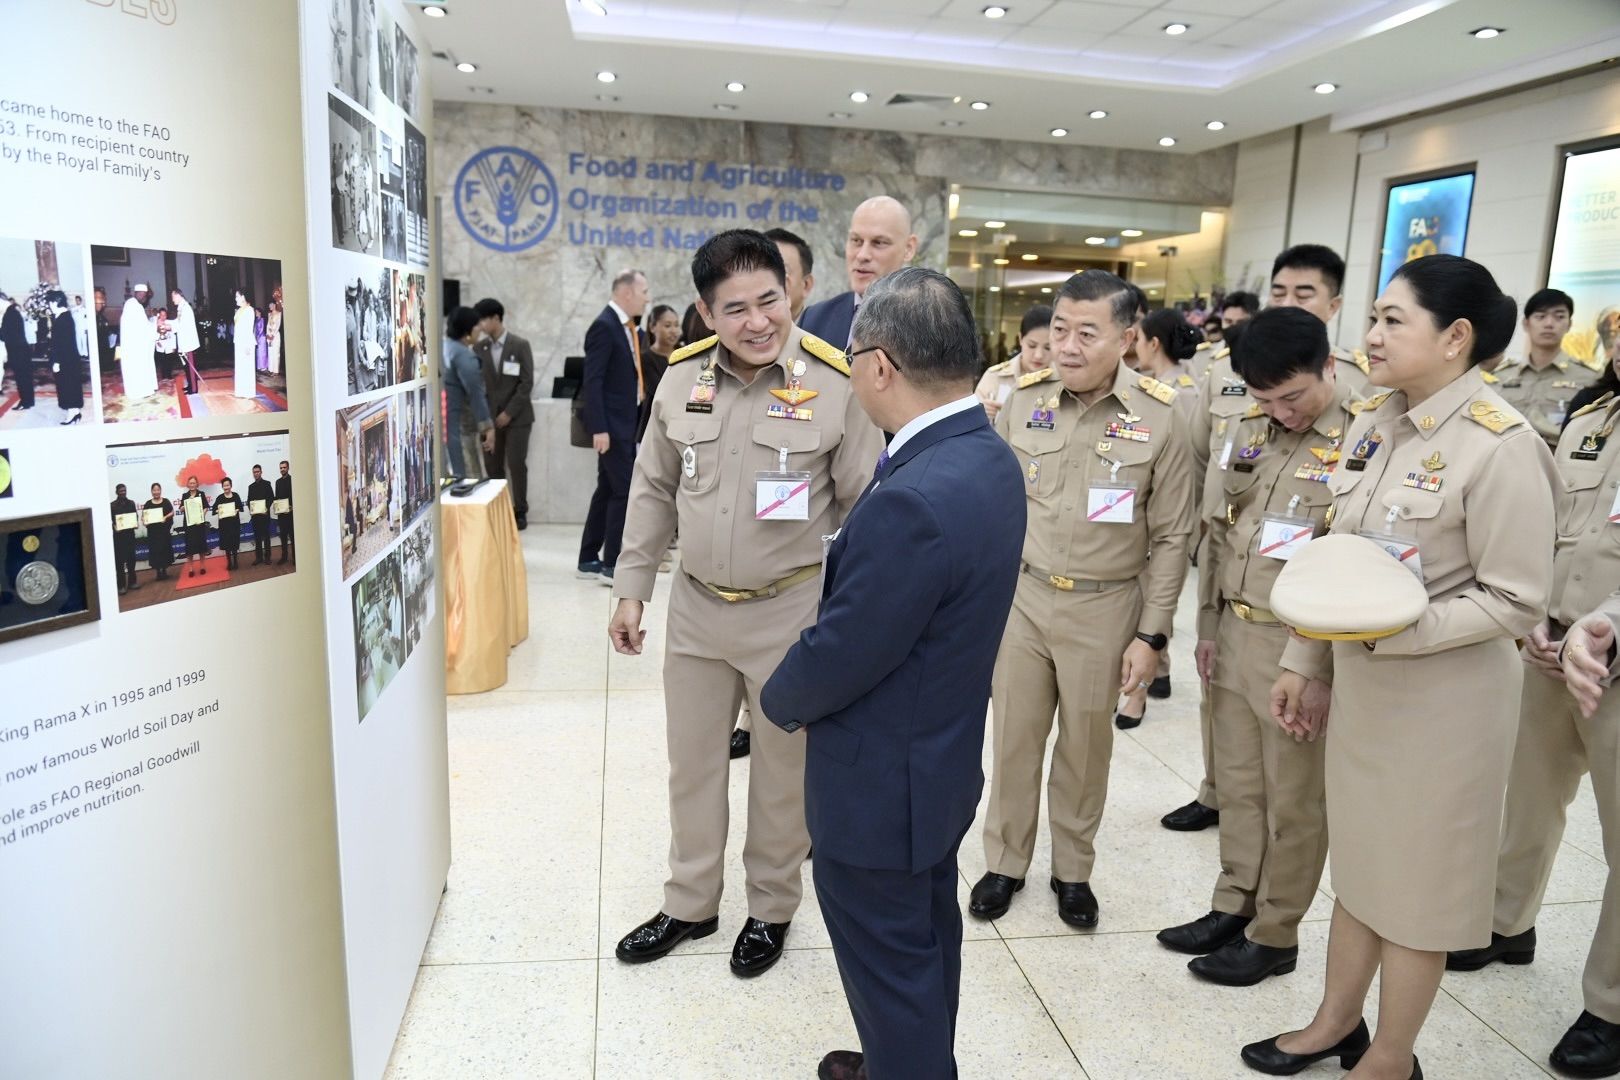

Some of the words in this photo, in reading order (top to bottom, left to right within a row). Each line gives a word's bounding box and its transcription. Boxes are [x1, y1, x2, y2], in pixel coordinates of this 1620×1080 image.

[0, 99, 46, 118] came
[50, 104, 94, 127] home
[98, 116, 113, 131] to
[117, 118, 139, 136] the
[143, 123, 170, 141] FAO
[2, 141, 21, 163] by
[27, 147, 52, 164] the
[57, 151, 99, 173] Royal
[103, 158, 161, 182] Family's
[26, 123, 67, 144] From
[72, 135, 135, 156] recipient
[138, 146, 189, 168] country
[568, 152, 638, 179] Food
[645, 159, 696, 183] and
[701, 159, 847, 192] Agriculture
[567, 187, 738, 219] Organization
[746, 197, 773, 220] of
[779, 200, 820, 224] the
[567, 221, 655, 248] United
[34, 710, 77, 732] Rama
[81, 703, 91, 718] X
[95, 700, 107, 714] in
[112, 687, 145, 708] 1995
[148, 678, 172, 697] and
[176, 669, 206, 688] 1999
[6, 762, 39, 784] now
[43, 742, 98, 771] famous
[101, 725, 140, 749] World
[144, 716, 167, 735] Soil
[171, 711, 194, 726] Day
[197, 699, 219, 717] and
[0, 808, 25, 825] ole
[29, 801, 48, 815] as
[51, 785, 81, 807] FAO
[84, 761, 143, 794] Regional
[147, 740, 201, 770] Goodwill
[21, 806, 80, 838] improve
[84, 783, 145, 814] nutrition.
